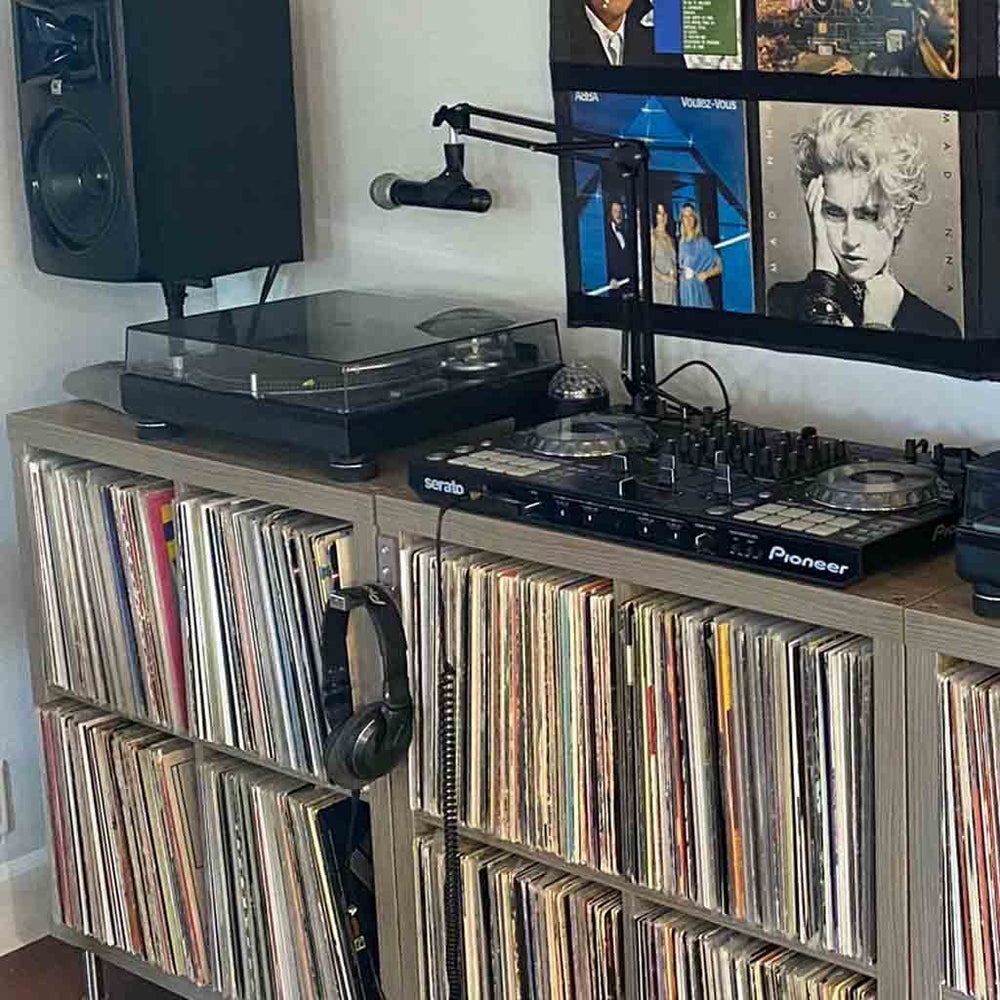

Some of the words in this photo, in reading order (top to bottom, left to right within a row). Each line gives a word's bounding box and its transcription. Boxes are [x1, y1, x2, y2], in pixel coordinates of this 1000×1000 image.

[943, 112, 954, 292] MADNNA
[424, 477, 465, 496] serato
[768, 546, 849, 575] Pioneer
